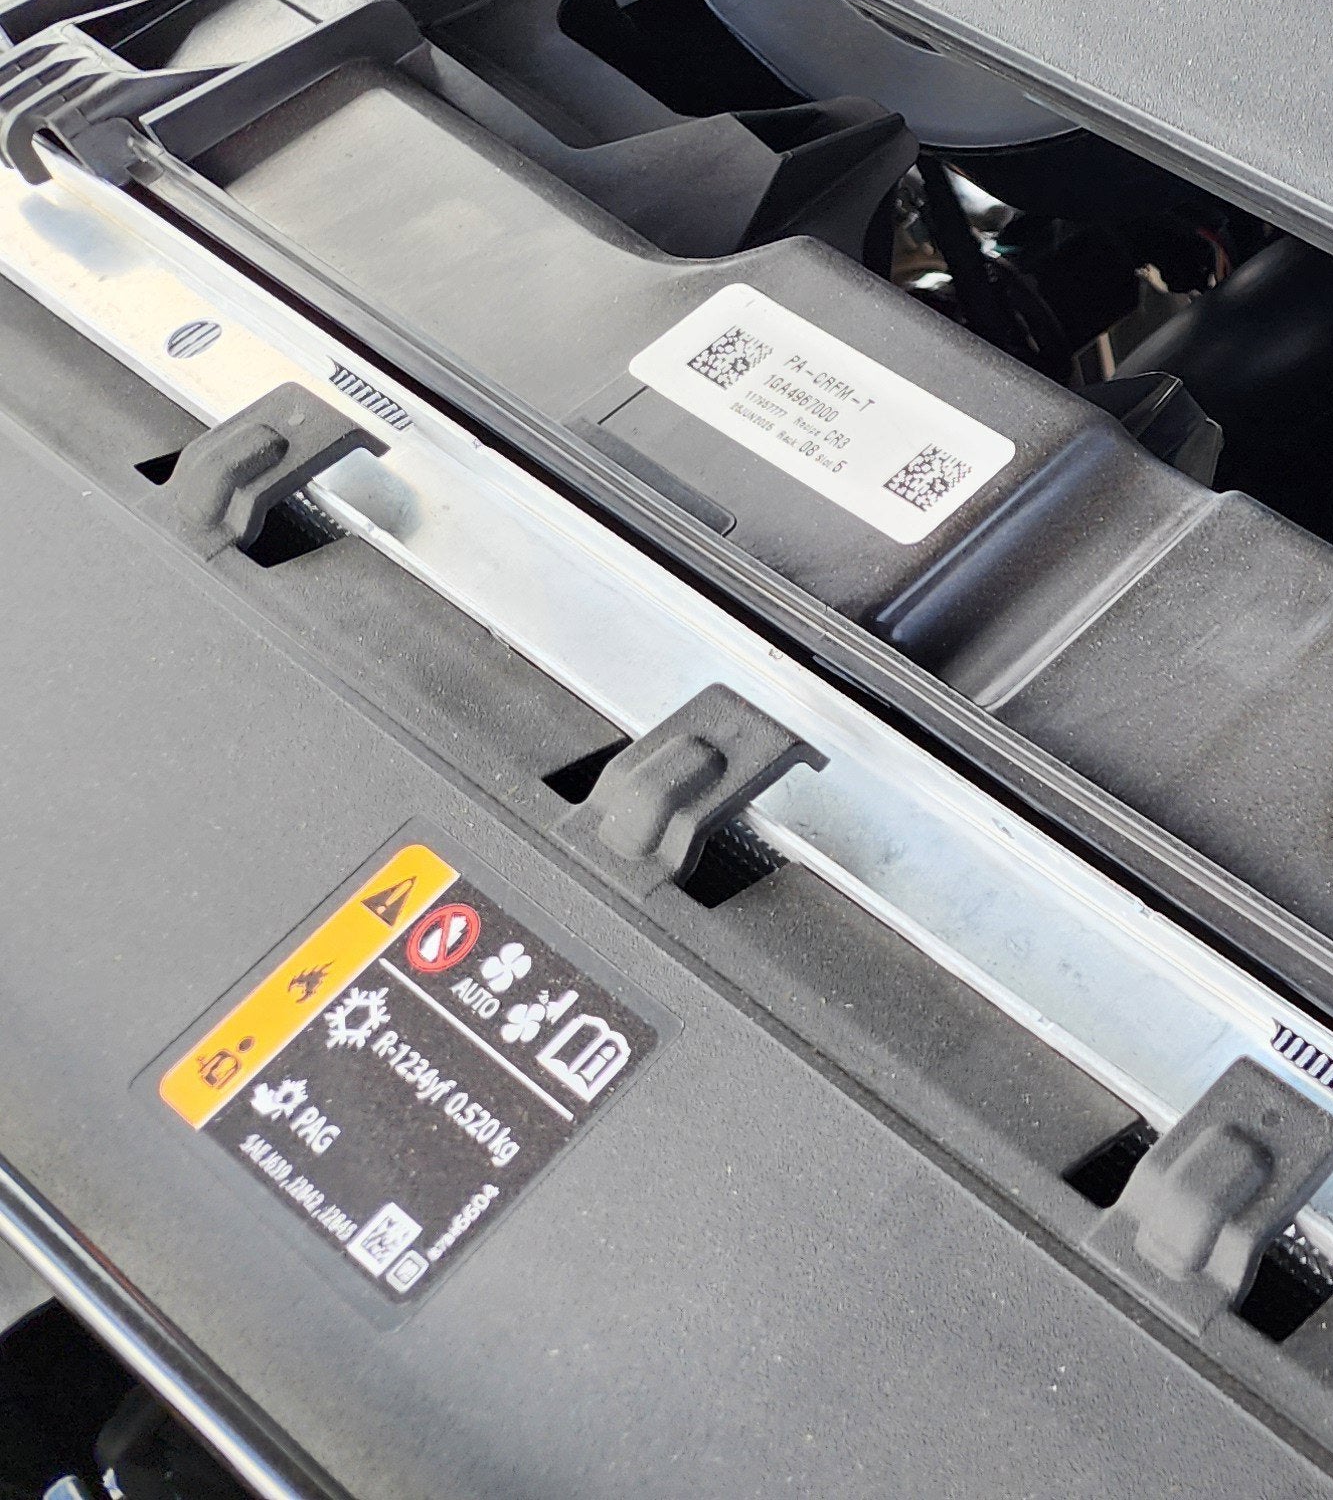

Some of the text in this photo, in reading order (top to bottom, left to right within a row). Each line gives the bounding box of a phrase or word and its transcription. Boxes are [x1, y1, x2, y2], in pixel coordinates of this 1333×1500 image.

[798, 439, 821, 457] 08
[823, 429, 851, 449] CR3
[449, 976, 501, 1020] AUTO
[370, 1030, 458, 1105] R-1234yf
[486, 1126, 521, 1169] kg
[239, 1133, 273, 1164] SAE
[289, 1105, 342, 1157] PAG
